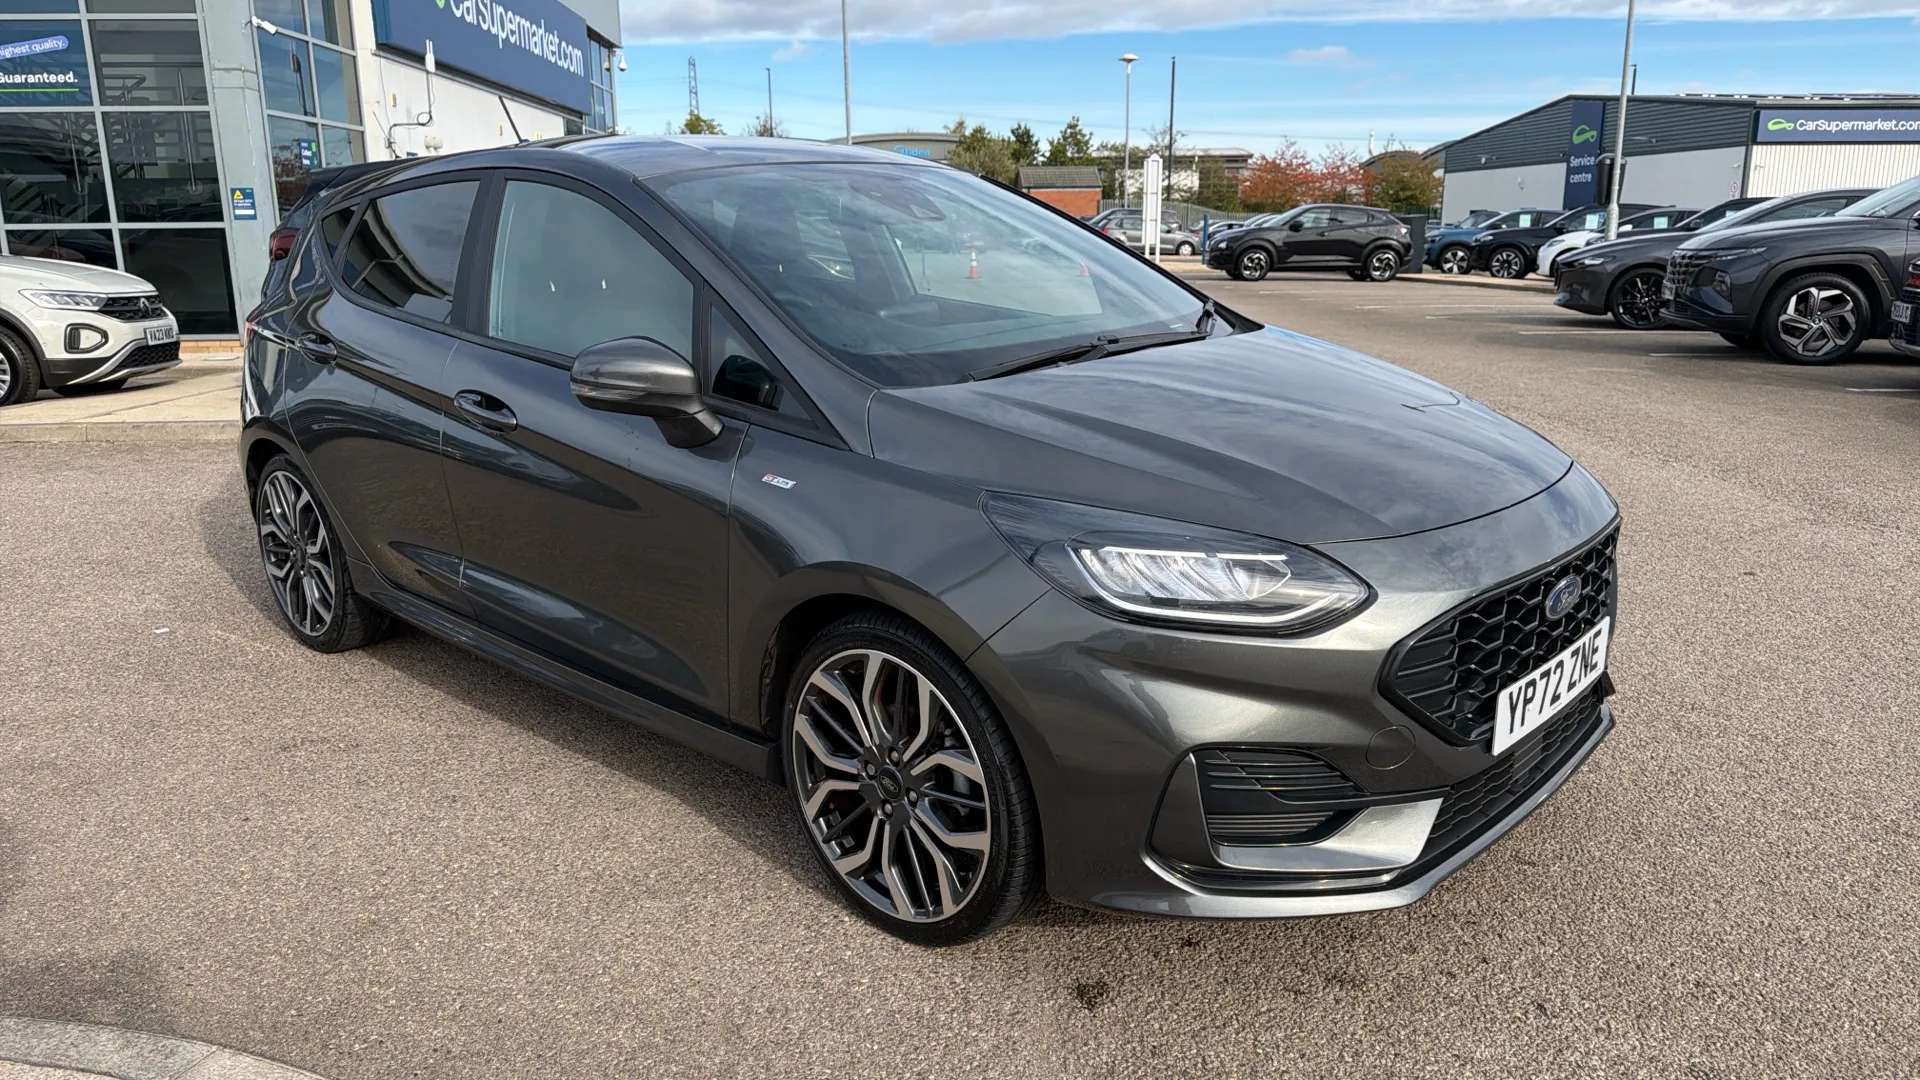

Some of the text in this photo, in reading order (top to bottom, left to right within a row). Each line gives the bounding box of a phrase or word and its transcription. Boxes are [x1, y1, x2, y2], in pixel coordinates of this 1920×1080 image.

[31, 39, 66, 53] quality.
[1569, 154, 1596, 167] Service
[1569, 172, 1593, 183] centre
[1508, 627, 1602, 735] YP72 ZNE
